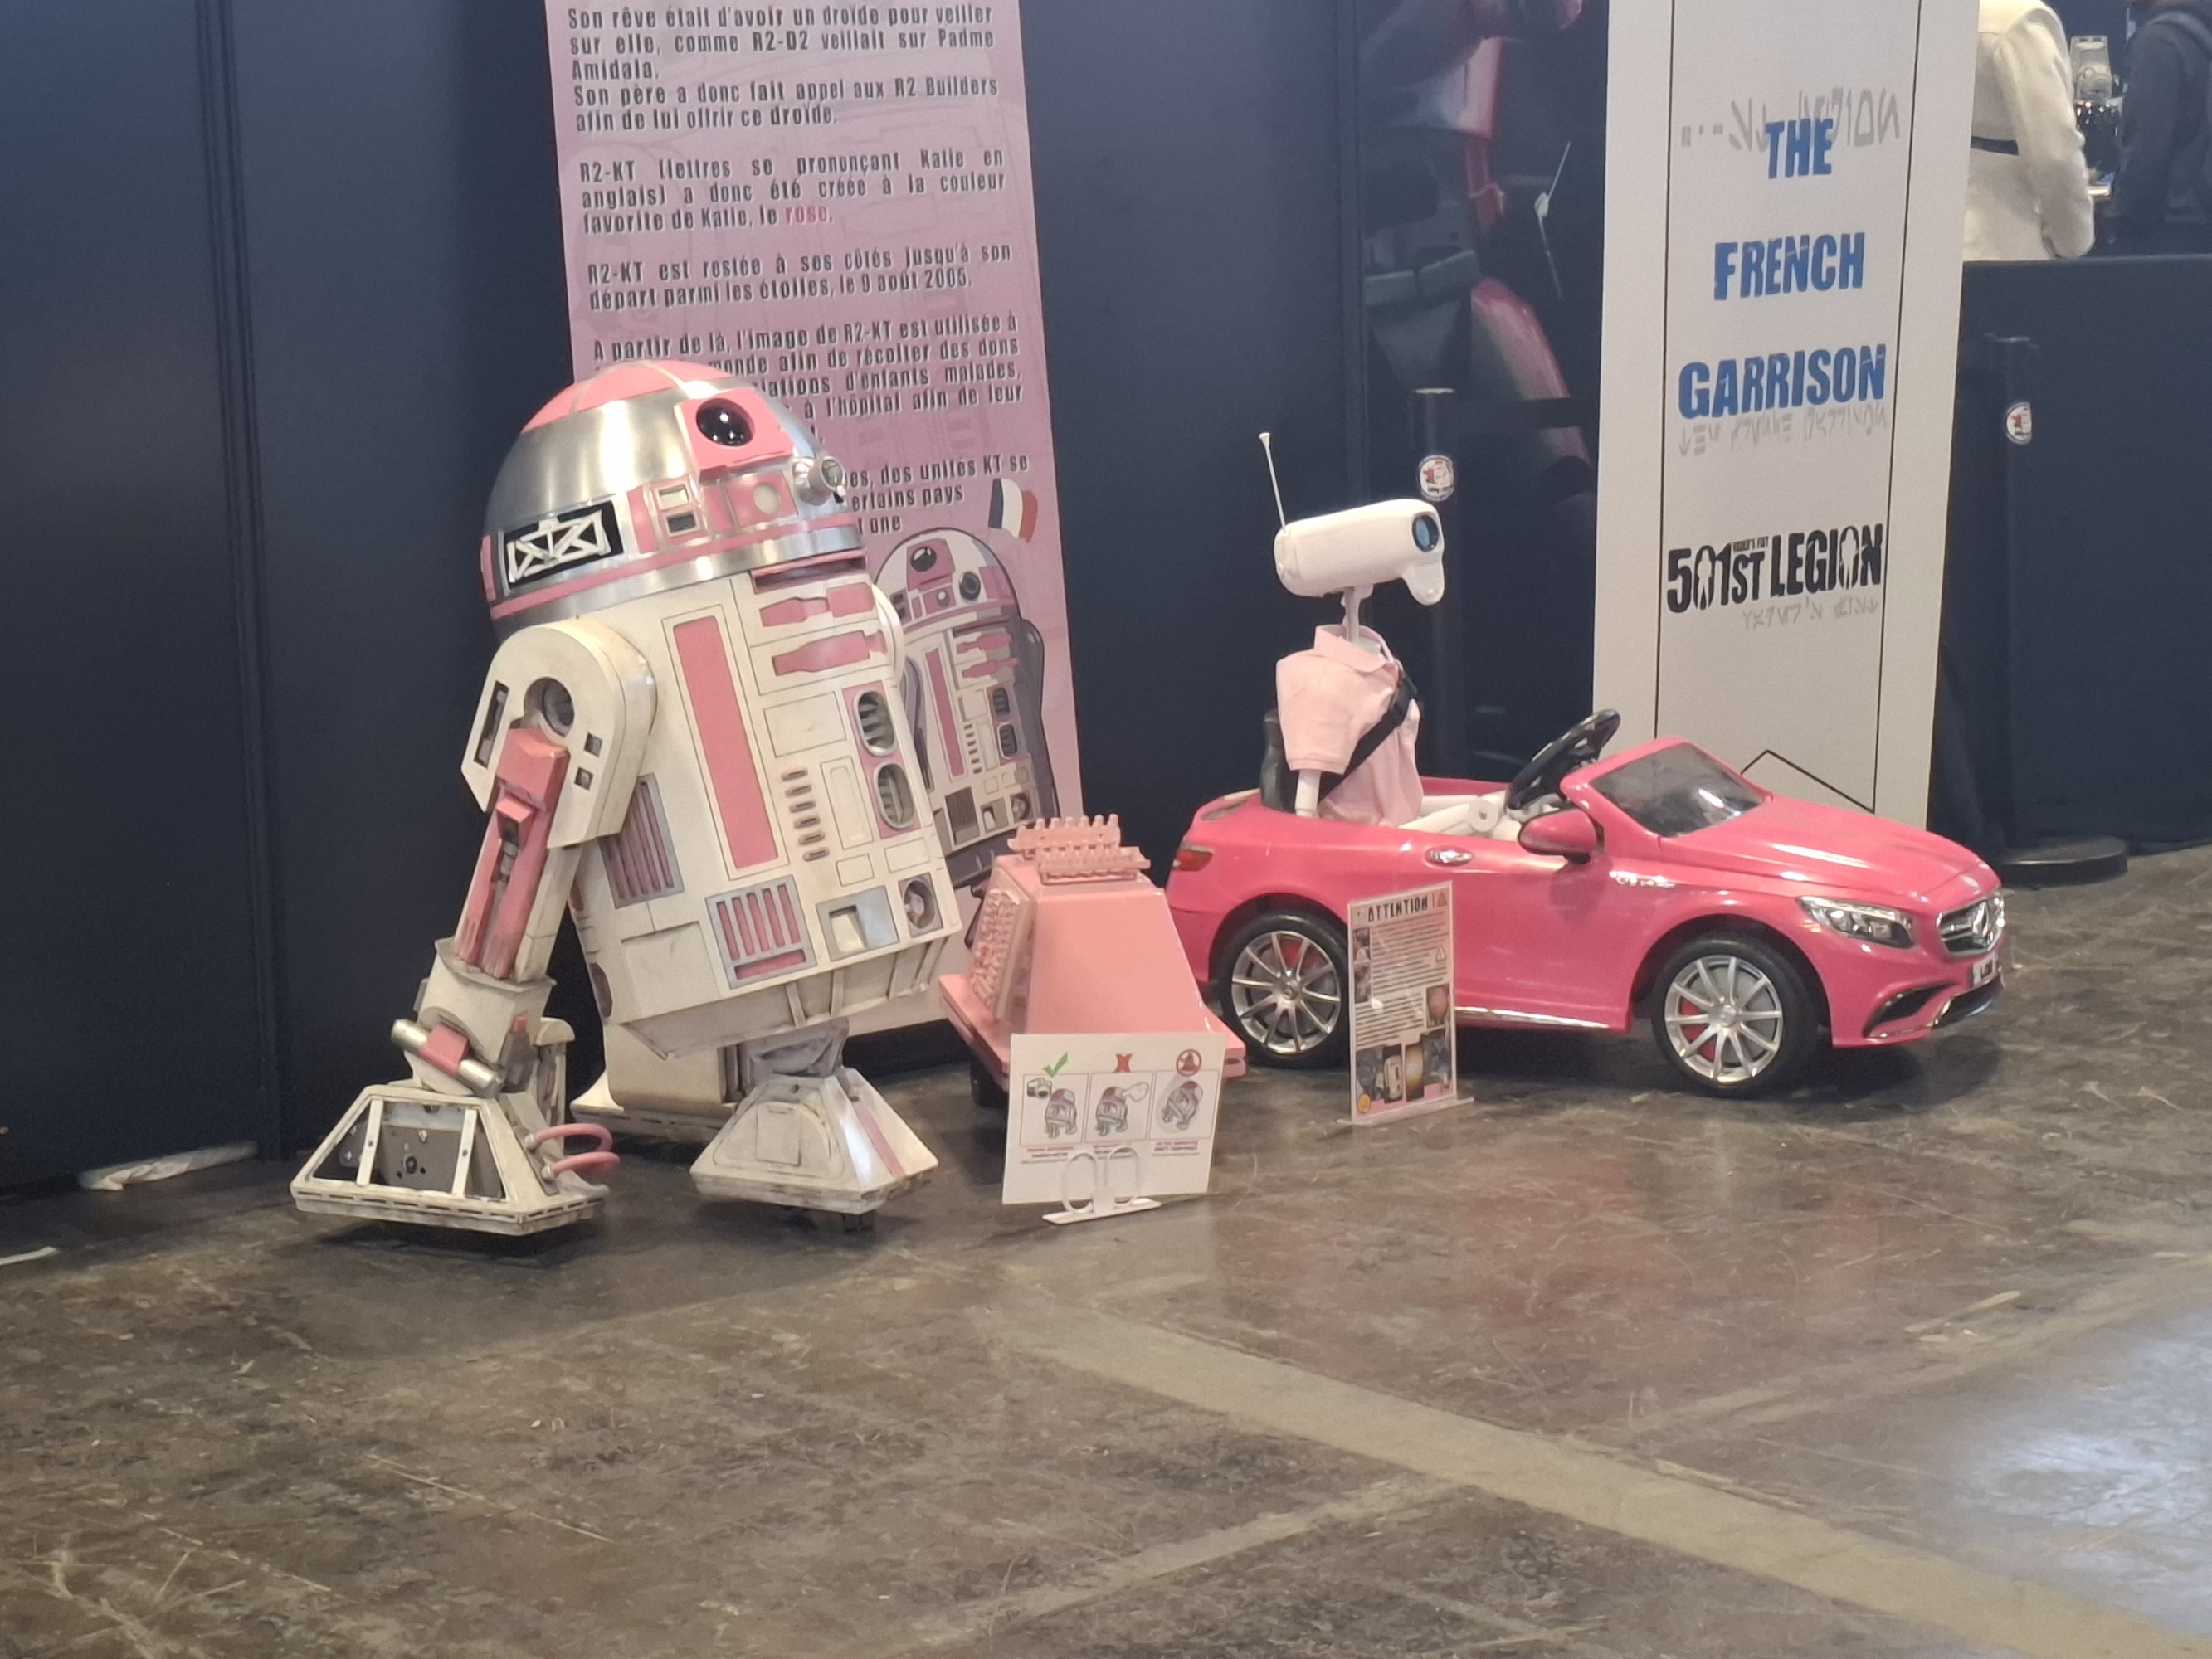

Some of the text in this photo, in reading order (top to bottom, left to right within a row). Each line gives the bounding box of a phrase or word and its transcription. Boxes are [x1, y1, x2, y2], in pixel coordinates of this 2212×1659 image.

[568, 8, 602, 28] Son
[793, 7, 815, 26] un
[889, 7, 928, 27] pour
[936, 4, 992, 24] veiller
[570, 36, 601, 55] sur
[675, 35, 738, 53] comme
[753, 30, 808, 51] R2-D2
[821, 29, 884, 50] veillait
[899, 32, 926, 48] sur
[574, 85, 609, 106] Son
[677, 85, 686, 103] a
[698, 82, 740, 103] donc
[751, 81, 785, 101] fait
[797, 79, 844, 100] appel
[854, 81, 884, 98] aux
[894, 77, 916, 96] R2
[926, 75, 997, 96] Builders
[576, 109, 614, 131] afin
[622, 109, 645, 129] de
[653, 107, 679, 129] lui
[687, 105, 733, 128] offrir
[741, 109, 762, 126] ce
[1763, 118, 1833, 179] THE
[580, 160, 635, 182] R2-KT
[752, 158, 773, 176] se
[921, 148, 964, 169] Katie
[983, 149, 1003, 166] en
[582, 184, 665, 209] anglais)
[684, 187, 693, 204] a
[710, 182, 753, 203] donc
[909, 173, 924, 193] la
[941, 171, 1005, 192] couleur
[584, 211, 663, 233] favorite
[672, 209, 694, 230] de
[760, 205, 777, 225] le
[588, 261, 642, 285] R2-KT
[659, 260, 688, 280] est
[801, 254, 832, 272] ses
[982, 245, 1011, 262] son
[1713, 231, 1865, 300] FRENCH
[665, 283, 719, 308] parmi
[726, 281, 752, 301] les
[840, 275, 855, 294] le
[861, 274, 870, 292] 9
[595, 340, 604, 360] A
[611, 337, 670, 361] partir
[680, 334, 701, 354] de
[816, 324, 836, 344] de
[844, 321, 892, 343] R2-KT
[900, 319, 927, 338] est
[779, 352, 817, 371] afin
[827, 350, 847, 368] de
[940, 340, 968, 359] des
[979, 338, 1017, 357] dons
[913, 391, 947, 410] afin
[958, 387, 977, 406] de
[988, 383, 1022, 402] leur
[1678, 344, 1886, 419] GARRISON
[881, 465, 911, 484] des
[983, 455, 1001, 474] KT
[1010, 455, 1028, 471] se
[852, 484, 963, 512] ertains pays
[870, 515, 901, 534] une
[1771, 523, 1883, 597] LEGION
[1368, 895, 1428, 922] ATTENTION
